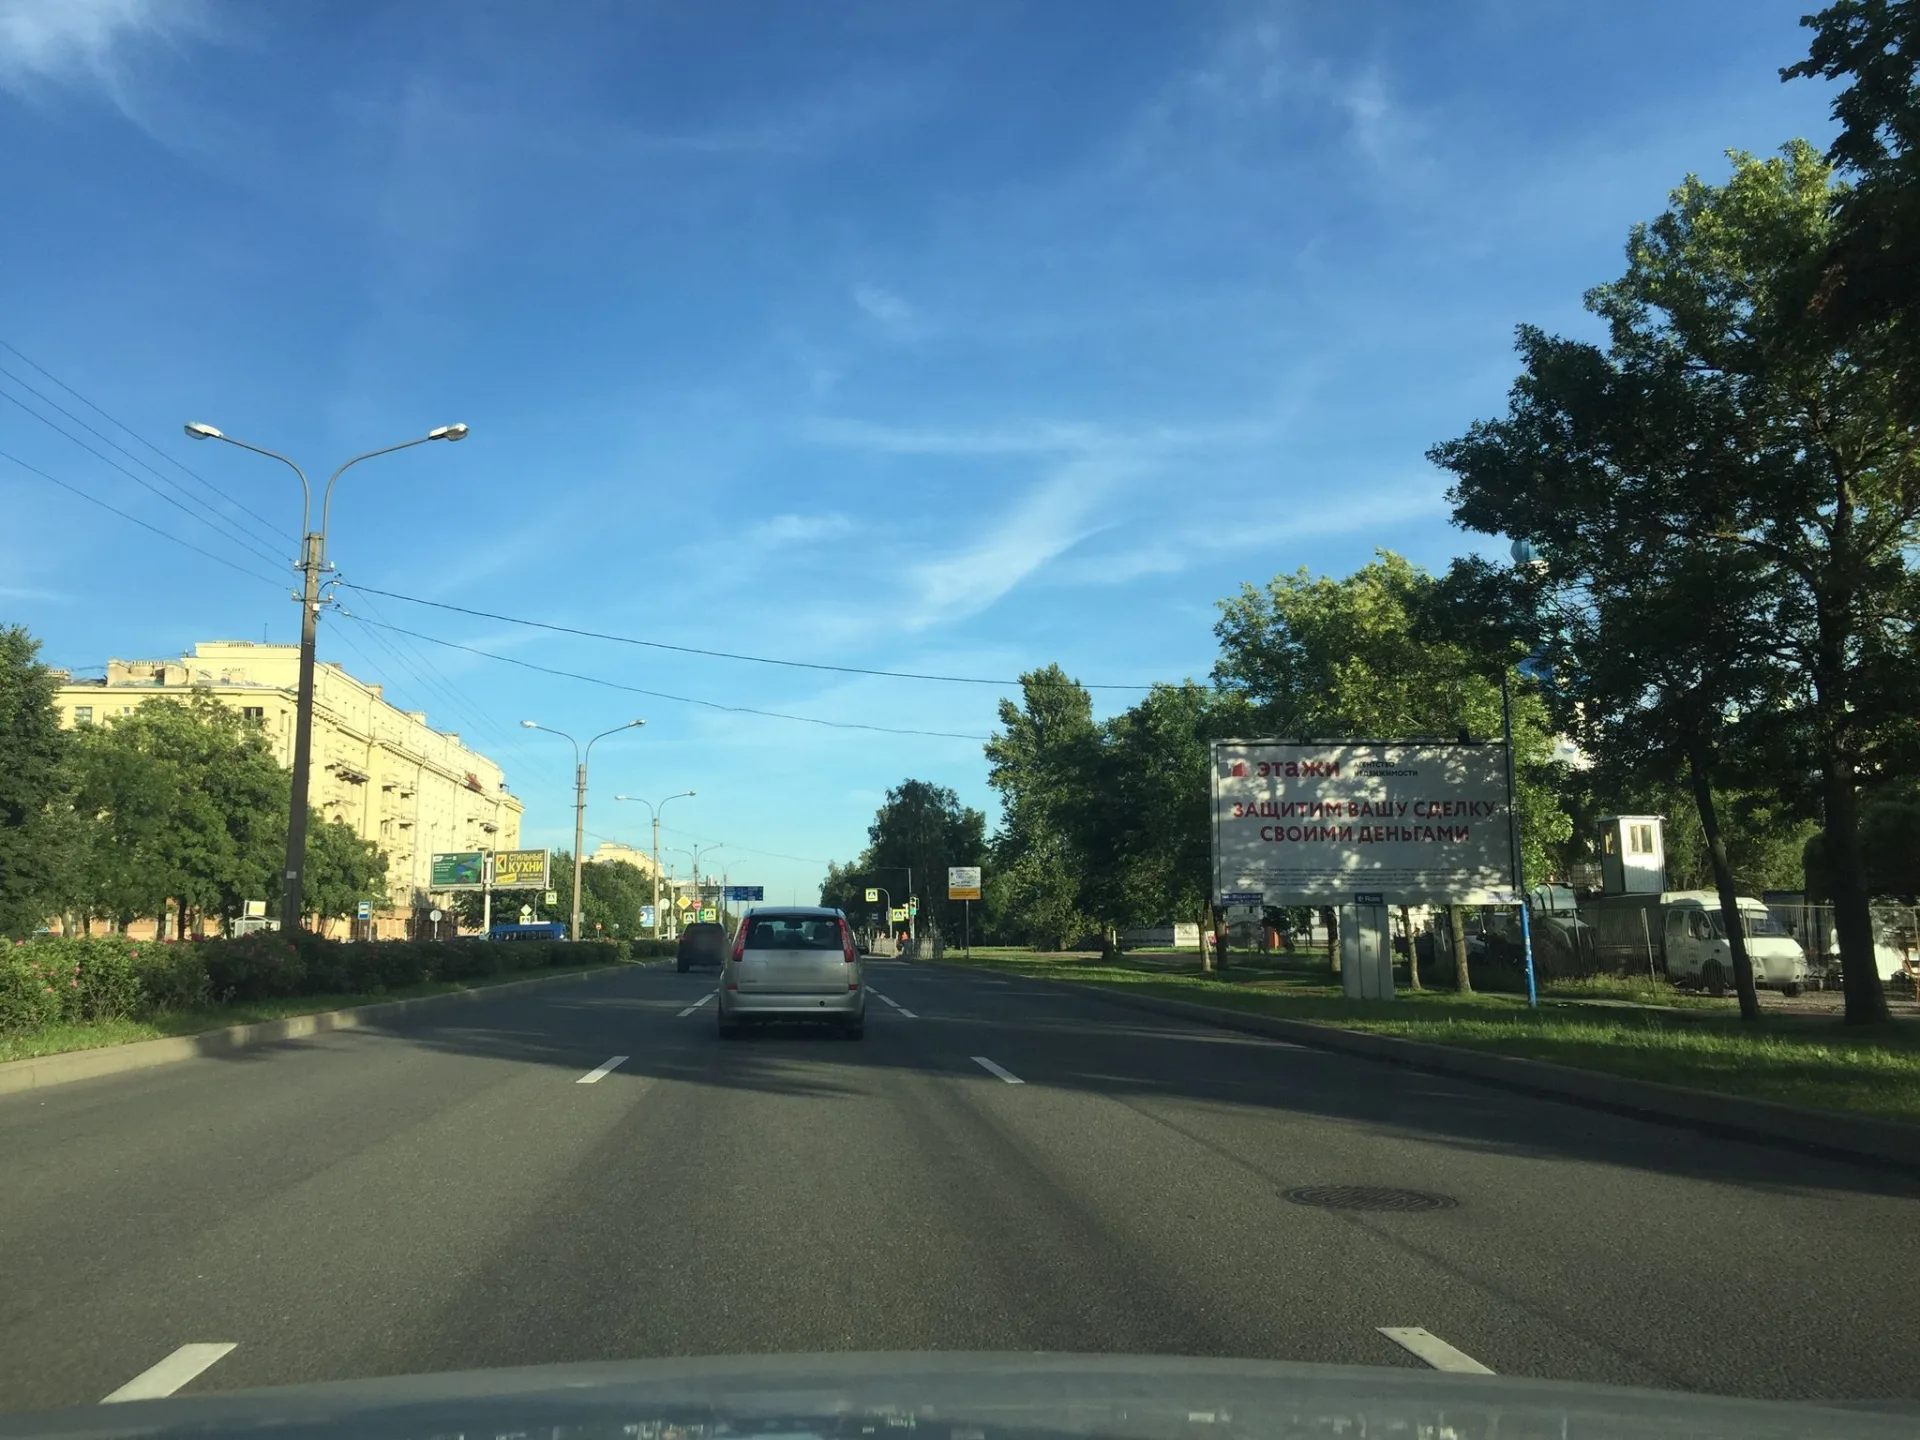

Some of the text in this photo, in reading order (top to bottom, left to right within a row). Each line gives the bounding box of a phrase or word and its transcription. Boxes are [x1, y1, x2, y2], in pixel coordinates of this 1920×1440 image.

[1233, 801, 1496, 819] ЗАЩИТИМ ВАШУ СДЕЛКУ
[1260, 826, 1469, 844] СВОИМИ ДЕНЬГАМИ
[509, 853, 543, 862] СТИЛЬНЫЕ
[508, 861, 544, 873] КУХНИ
